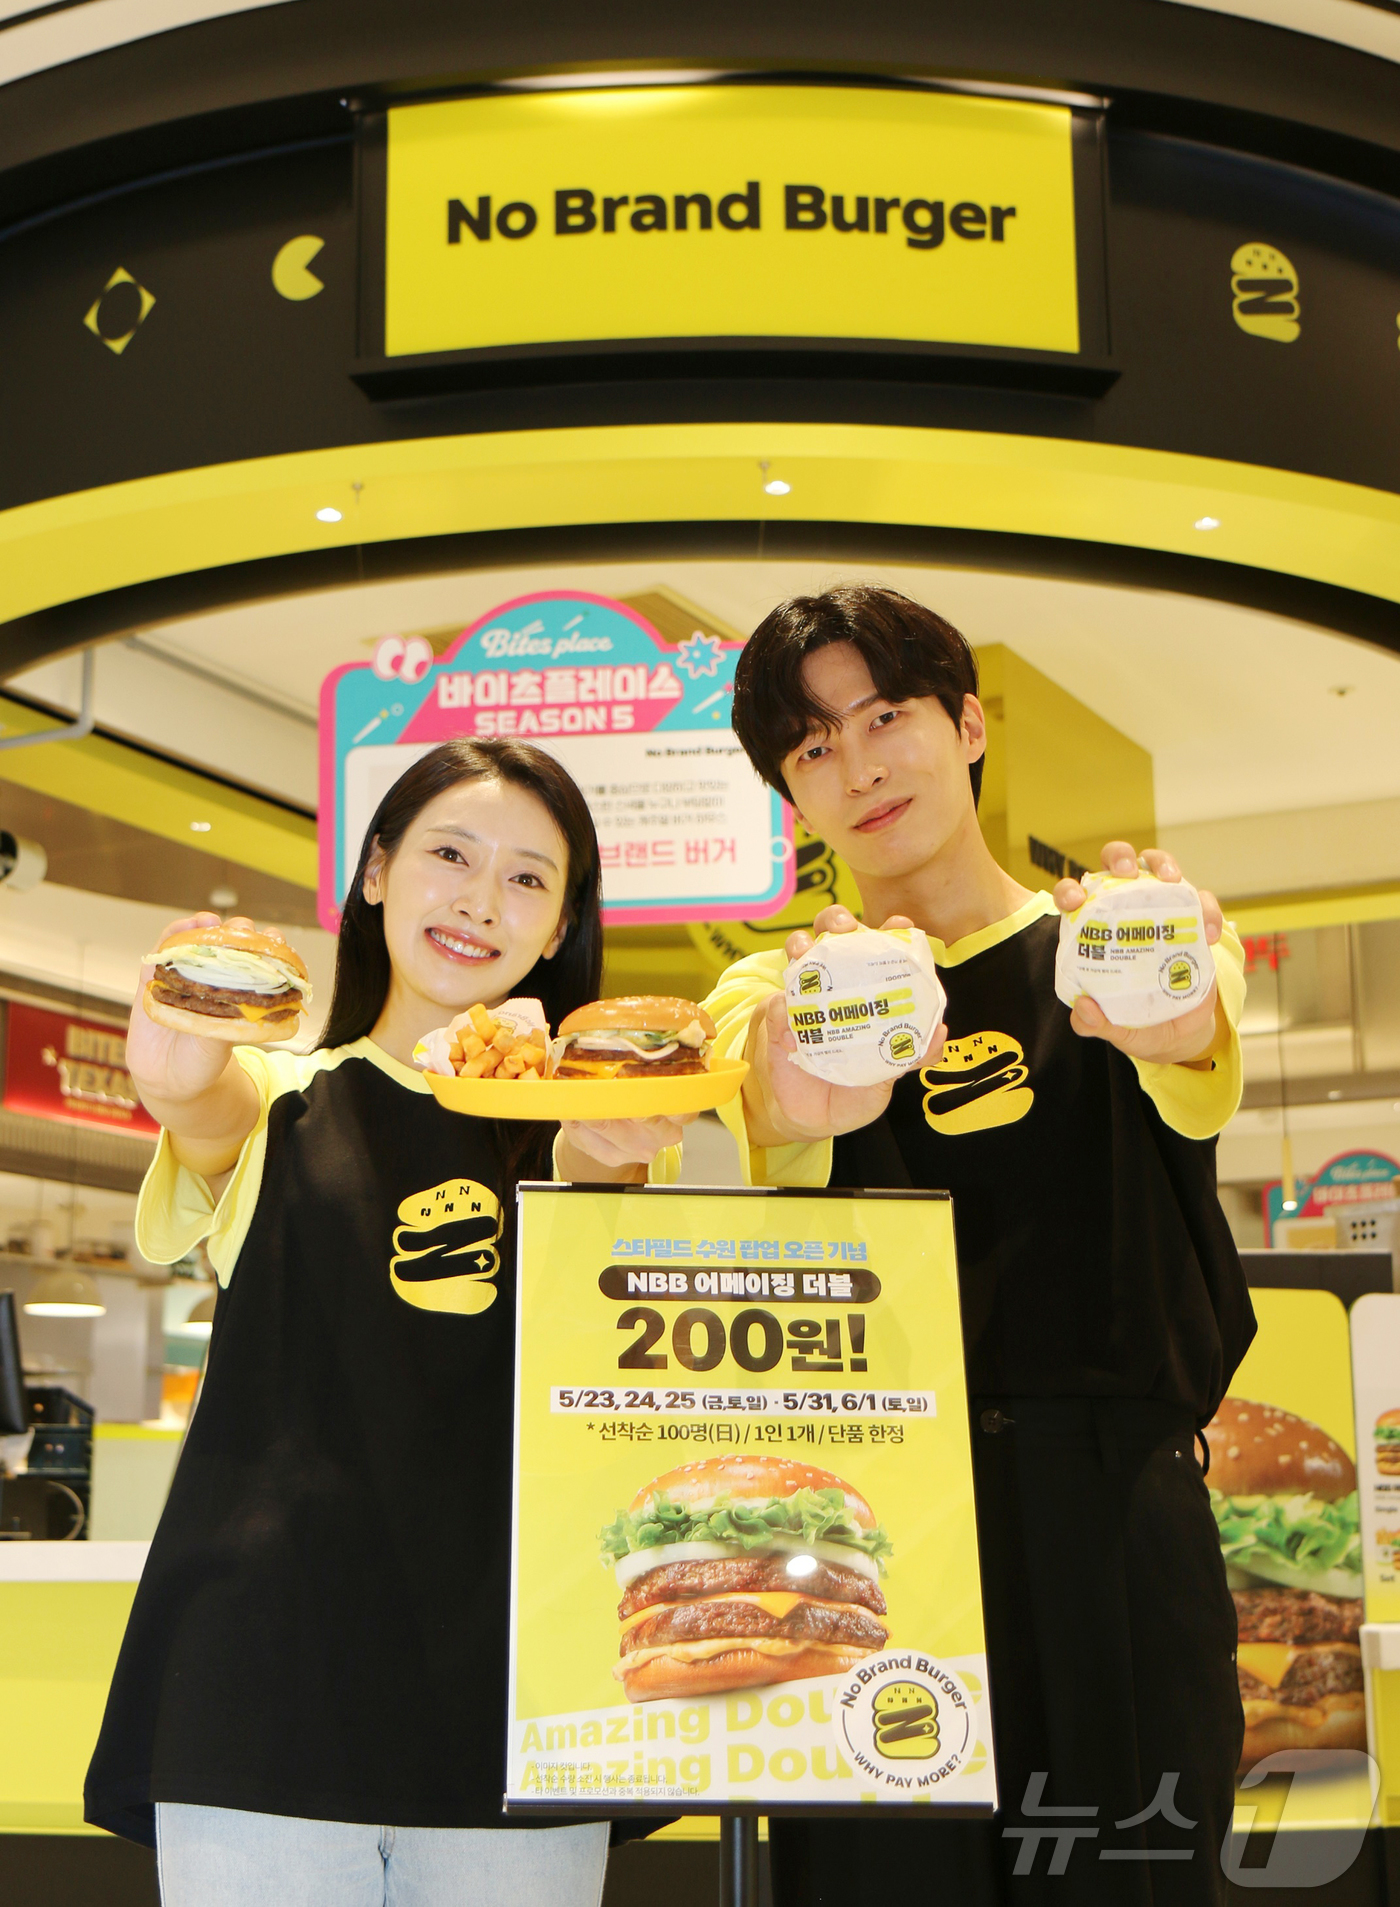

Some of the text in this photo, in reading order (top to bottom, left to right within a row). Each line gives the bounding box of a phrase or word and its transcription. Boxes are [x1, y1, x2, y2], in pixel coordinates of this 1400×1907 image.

[447, 181, 1017, 250] No Brand Burger
[480, 628, 614, 659] Bites place
[437, 664, 684, 708] 바이츠플레이스
[474, 705, 635, 736] SEASON 5
[685, 838, 736, 864] 버거
[1080, 924, 1175, 943] NBB 어메이징
[1078, 943, 1106, 961] 더블
[793, 998, 890, 1027] NBB 어메이징
[798, 1028, 824, 1044] 더블
[828, 1034, 854, 1042] DOUBLE
[611, 1238, 868, 1262] 스타필드 수원 팝업 오픈 기념
[627, 1272, 853, 1298] NBB 어메이징 더블
[616, 1306, 868, 1373] 200원!
[599, 1421, 654, 1441] 선착순
[657, 1422, 741, 1444] 100명(日)
[754, 1424, 783, 1443] 1인
[787, 1424, 815, 1443] 1개
[828, 1424, 864, 1444] 단품
[868, 1424, 904, 1444] 한정
[840, 1655, 967, 1710] No Brand Burger
[519, 1704, 711, 1753] Amazing
[519, 1750, 711, 1793] Amazing
[535, 1762, 558, 1771] 이미지
[854, 1751, 962, 1788] WHY PAY MORE?
[544, 1787, 567, 1795] 이벤트
[635, 1787, 666, 1796] 적용되지
